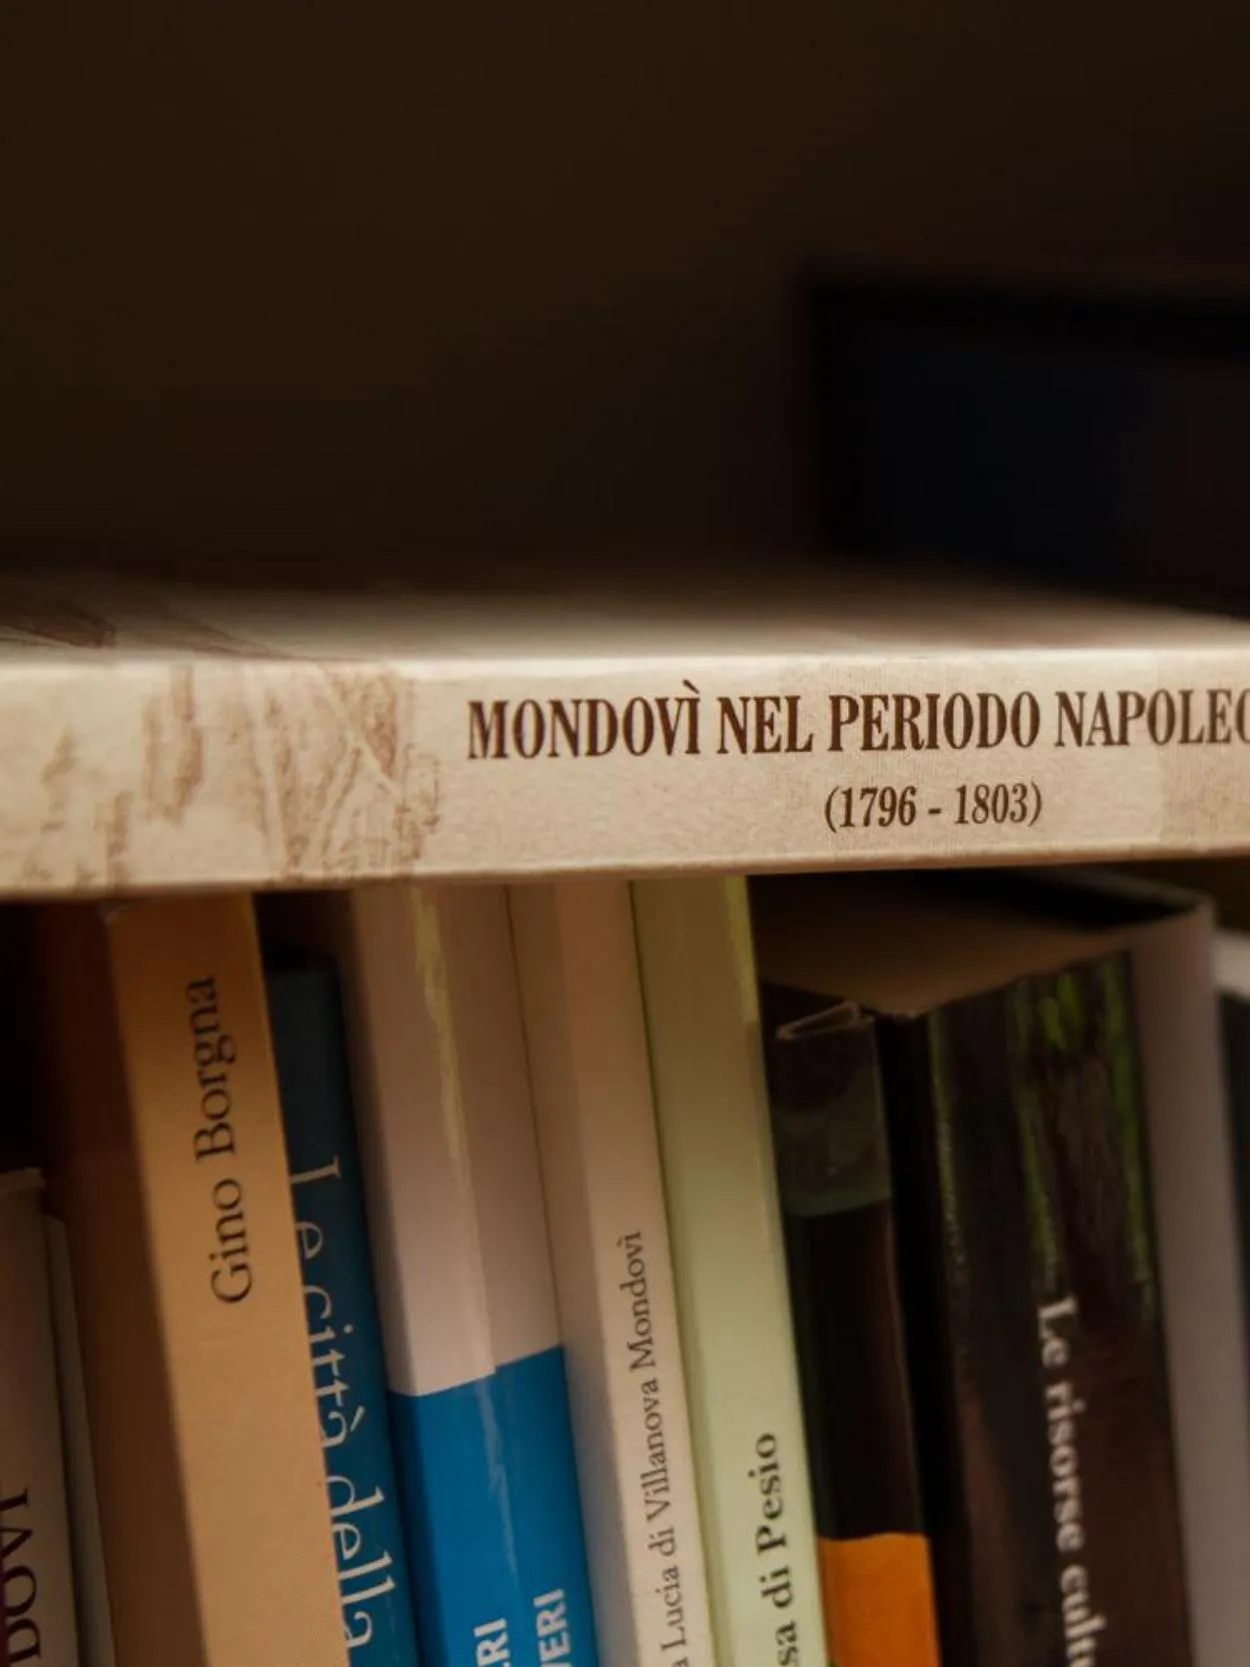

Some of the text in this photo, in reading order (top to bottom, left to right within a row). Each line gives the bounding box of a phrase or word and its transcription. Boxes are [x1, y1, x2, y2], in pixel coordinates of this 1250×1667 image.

[467, 679, 702, 759] MONDOVÌ
[717, 694, 814, 755] NEL
[827, 691, 1041, 752] PERIODO
[824, 786, 917, 833] (1796
[954, 781, 1043, 827] 1803)
[186, 976, 252, 1303] Gino Borgna
[616, 1231, 656, 1373] Mondovì
[1038, 1296, 1077, 1368] Le
[640, 1378, 671, 1522] Villanova
[1046, 1381, 1085, 1551] risorse
[748, 1433, 788, 1556] Pesio
[326, 1475, 396, 1649] della
[648, 1526, 675, 1557] di
[533, 1588, 573, 1667] ERI
[655, 1566, 687, 1651] Lucia
[760, 1566, 794, 1609] di
